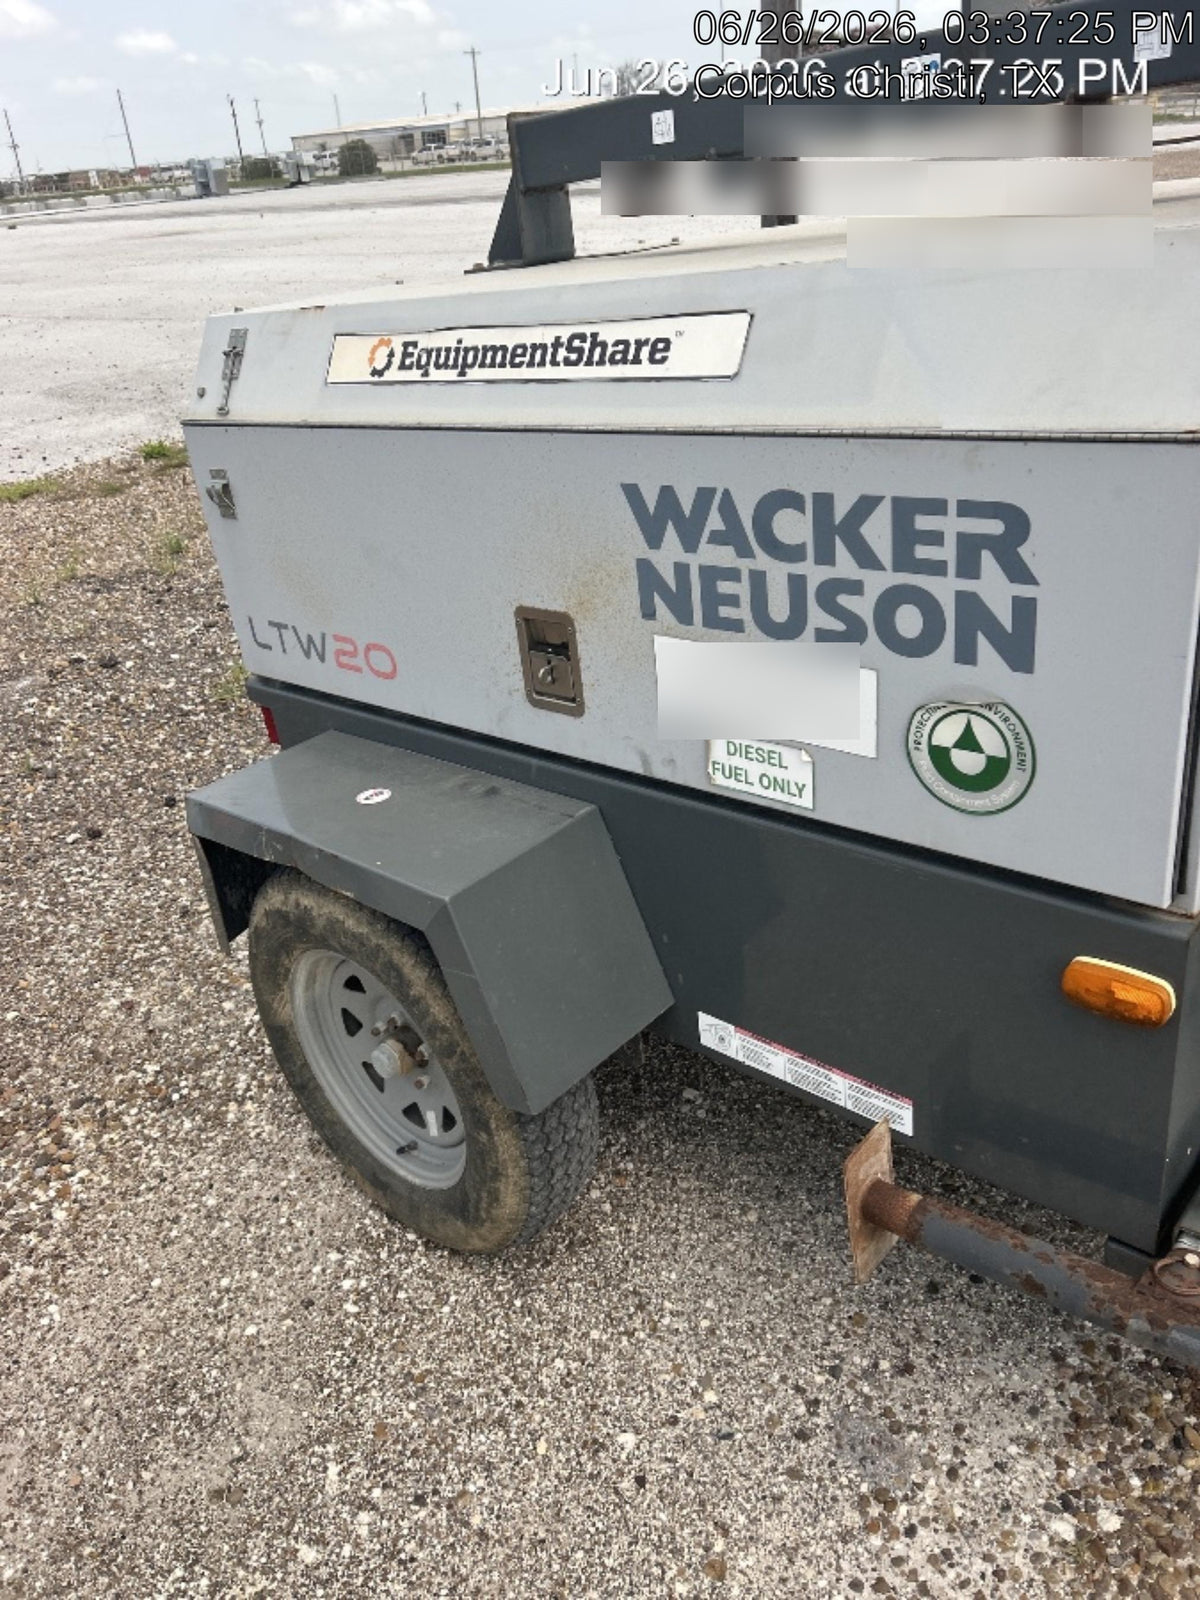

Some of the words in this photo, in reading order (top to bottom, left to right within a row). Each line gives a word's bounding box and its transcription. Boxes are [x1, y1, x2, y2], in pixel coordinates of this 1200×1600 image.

[398, 332, 672, 377] EquipmentShare
[620, 483, 1040, 586] WACKER
[248, 615, 398, 680] LTW20
[635, 557, 1038, 675] NEUSON
[726, 741, 788, 770] DIESEL
[979, 703, 1027, 773] NVIRONMENT
[711, 761, 754, 786] FUEL
[758, 773, 806, 799] ONLY
